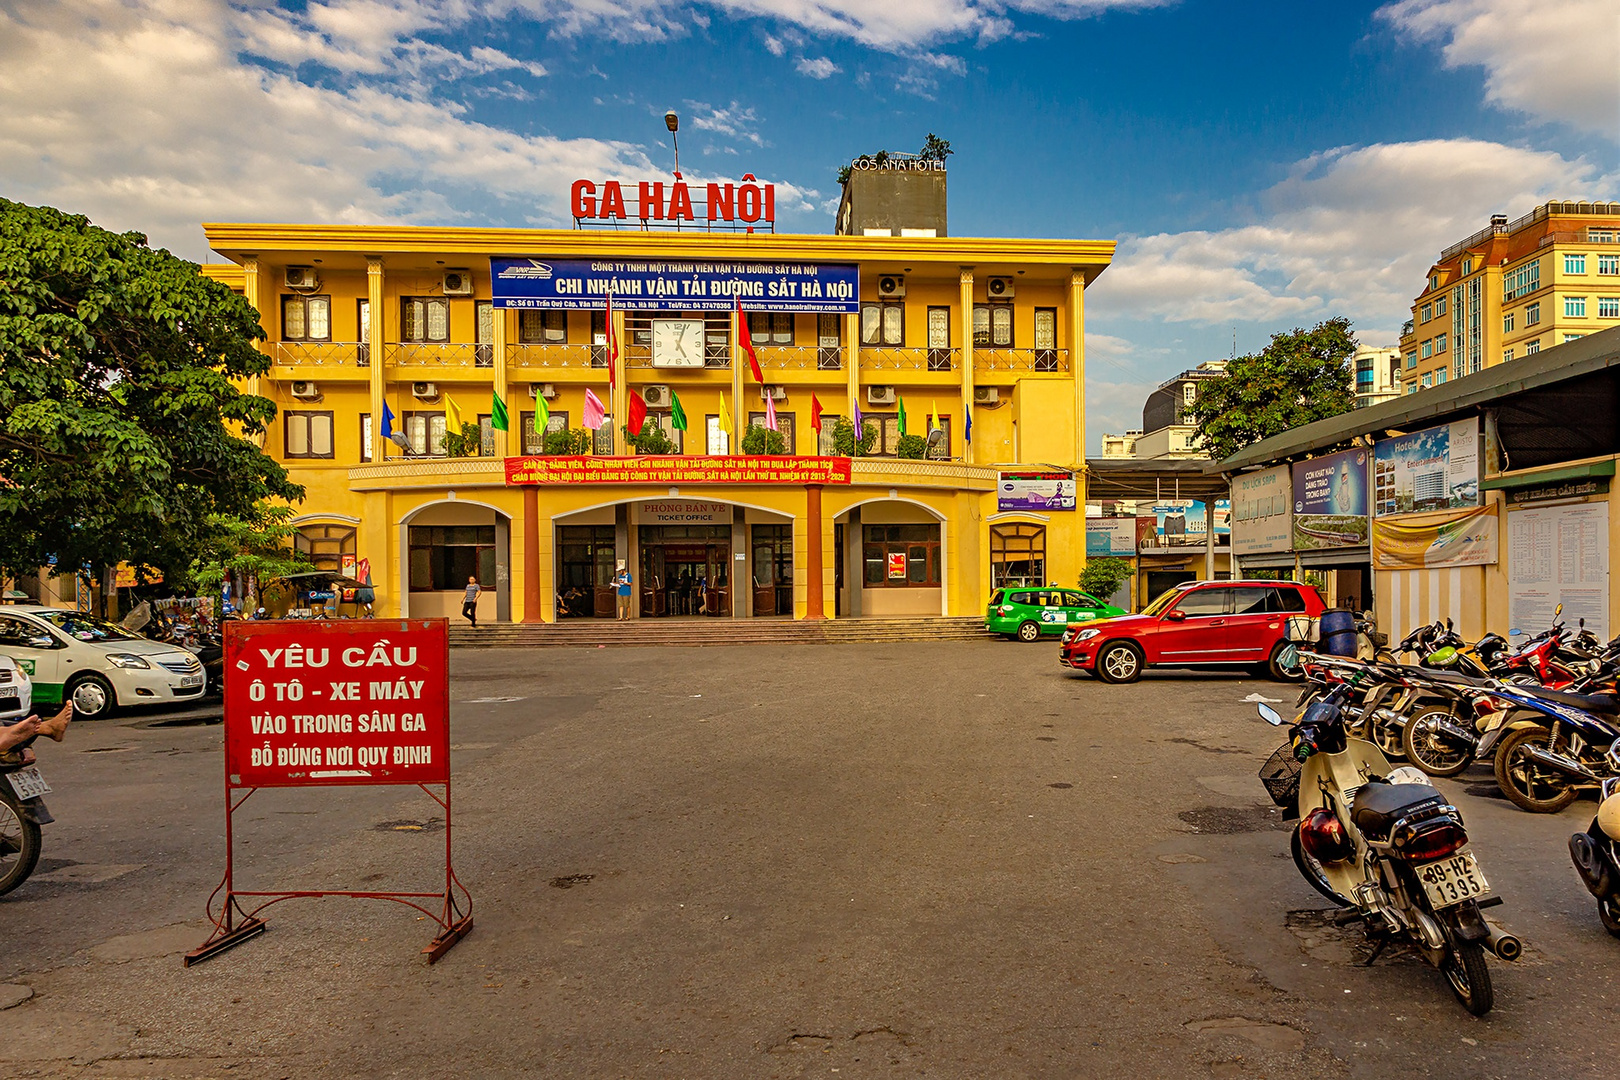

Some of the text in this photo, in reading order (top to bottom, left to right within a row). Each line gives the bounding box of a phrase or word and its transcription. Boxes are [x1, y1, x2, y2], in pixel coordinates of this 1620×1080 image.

[909, 159, 947, 172] HOTEL
[571, 172, 775, 233] GA HÀ NỘI
[591, 262, 818, 276] CÔNG TY TNHH MỘT THÀNH VIÊN VẬN TẢI ĐƯỜNG SẮT HÀ NỘI
[555, 274, 853, 300] CHI NHÁNH VẬN TẢI ĐƯỜNG SẮT HÀ NỘI
[1394, 438, 1415, 453] Hotel
[1453, 436, 1473, 447] ARISTO
[623, 459, 638, 469] VIÊN
[639, 460, 650, 469] CHI
[737, 459, 747, 468] HÀ
[747, 459, 759, 470] NỘI
[760, 460, 770, 469] THI
[1407, 454, 1444, 468] Entertainment
[649, 472, 657, 480] TY
[720, 470, 729, 480] HÀ
[810, 472, 825, 480] 2015
[830, 473, 845, 481] 2020
[644, 502, 682, 512] PHÒNG
[686, 502, 708, 512] BÁN
[259, 639, 418, 668] YÊU CẦU
[249, 678, 266, 701] Ô
[273, 678, 304, 701] TÔ
[329, 682, 361, 701] XE
[369, 676, 425, 700] MÁY
[251, 710, 426, 734] VÀO TRONG SÂN GA
[251, 740, 432, 768] ĐỖ ĐÚNG NƠI QUY ĐỊNH
[1426, 856, 1472, 885] 99-H2
[1436, 875, 1480, 903] 1395
